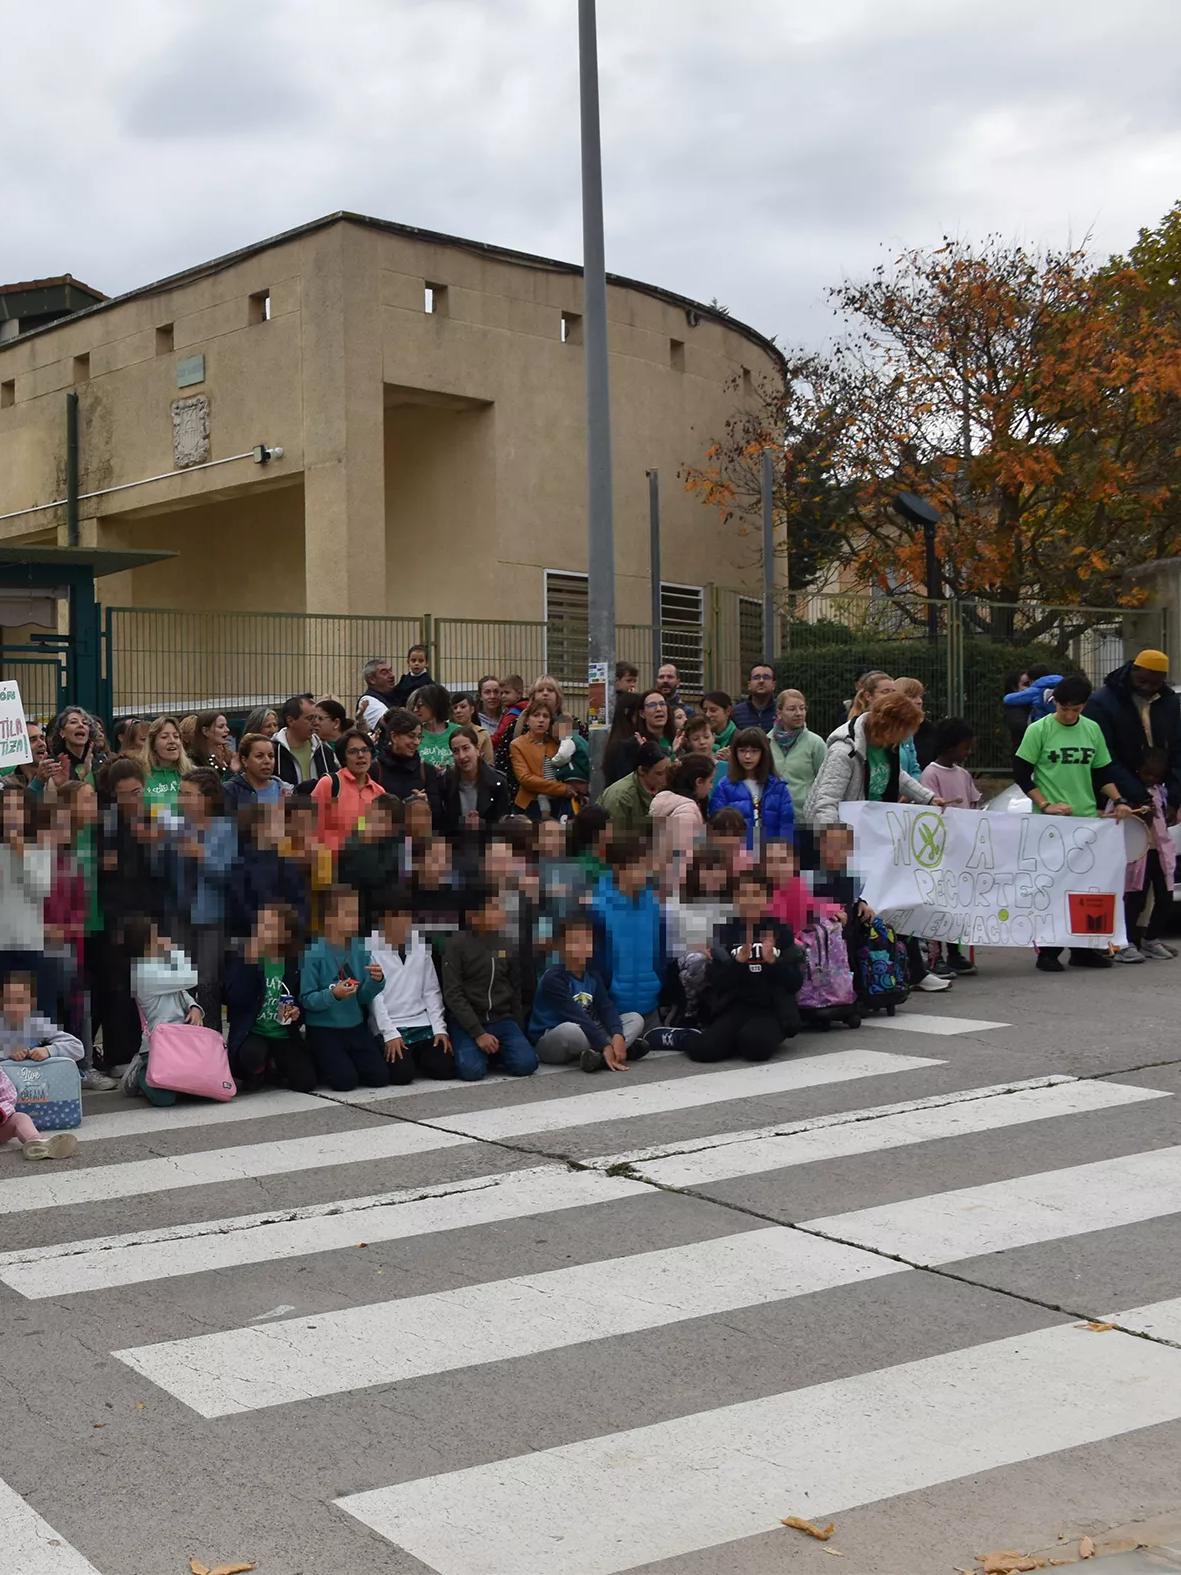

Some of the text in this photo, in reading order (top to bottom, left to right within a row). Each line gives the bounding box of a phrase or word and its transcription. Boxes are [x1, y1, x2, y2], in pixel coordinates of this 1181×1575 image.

[966, 817, 995, 870] A
[1017, 817, 1098, 875] LOS
[914, 868, 1055, 912] RECORTES
[921, 908, 1057, 945] EDUCACIÓN
